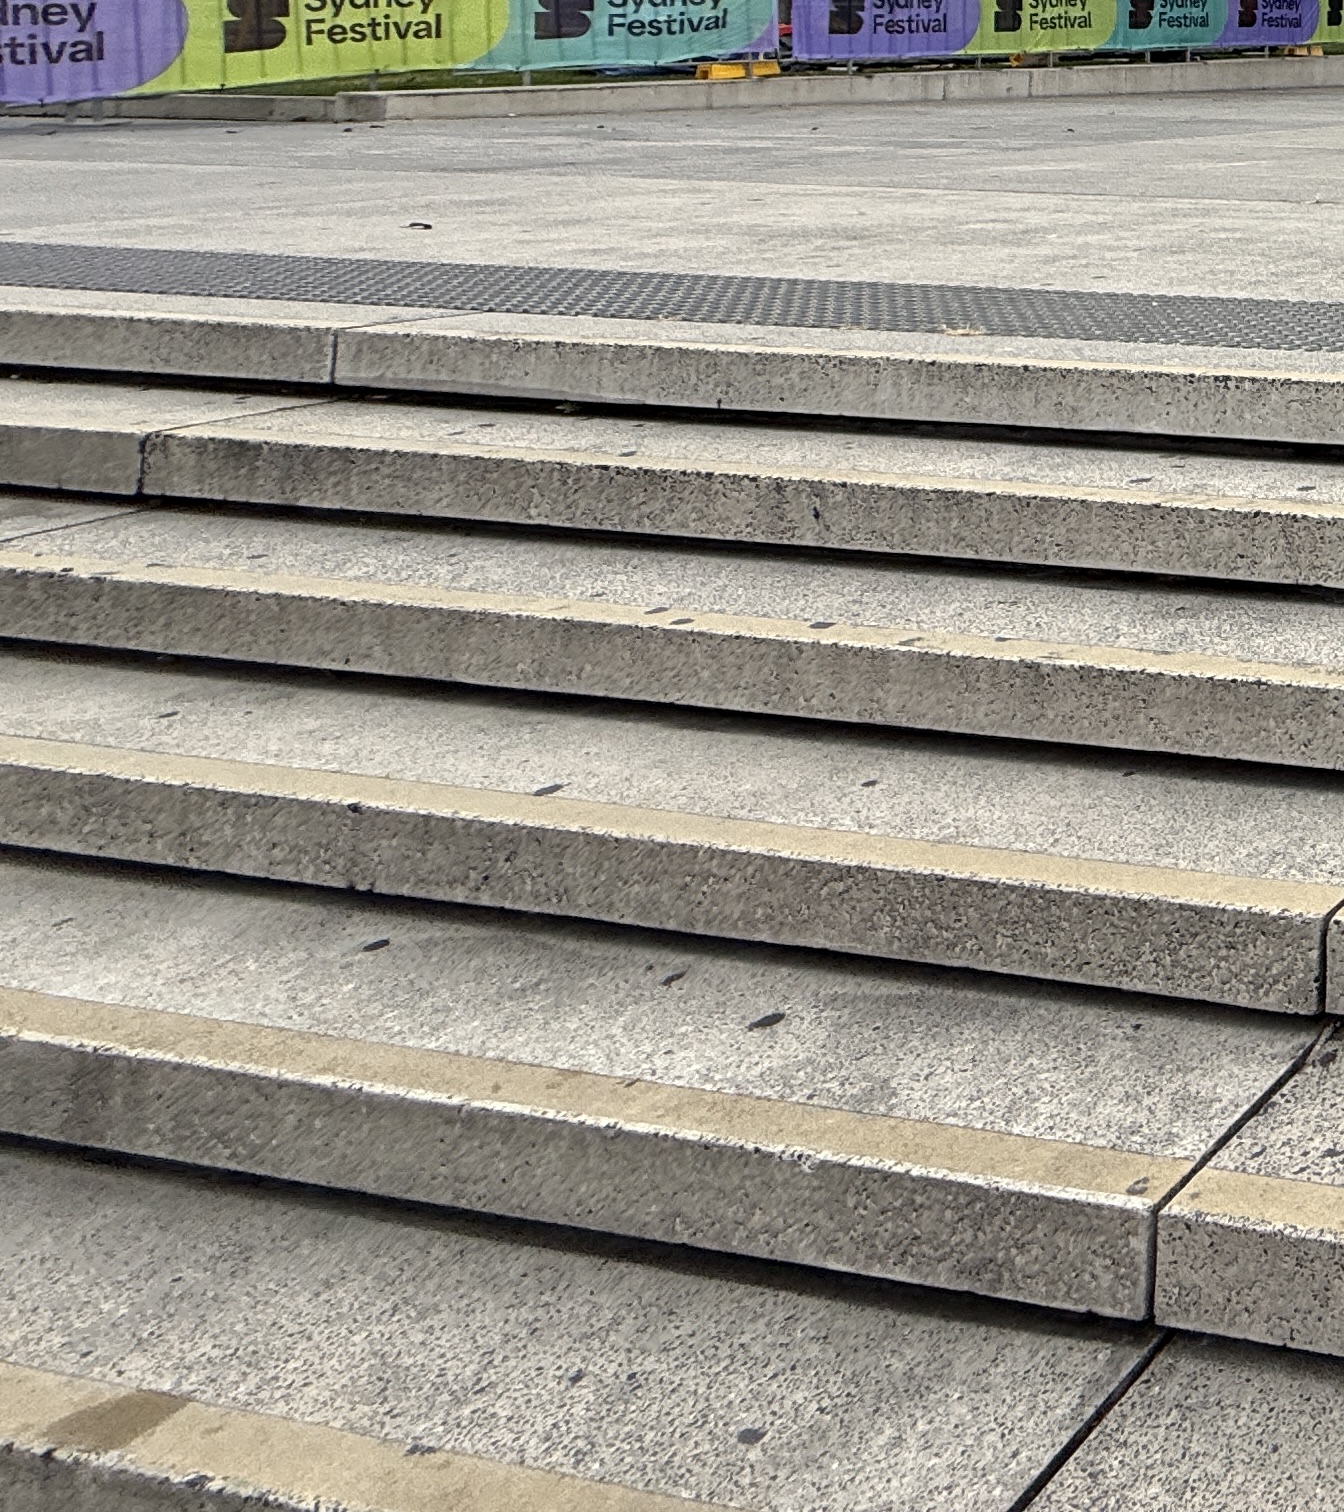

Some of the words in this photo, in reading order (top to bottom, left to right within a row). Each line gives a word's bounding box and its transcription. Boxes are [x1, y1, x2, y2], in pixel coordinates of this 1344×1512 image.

[305, 13, 442, 46] Festival
[607, 8, 728, 37] Festival
[873, 12, 947, 35] Festival
[1029, 10, 1092, 31] Festival
[1159, 11, 1209, 29] Festival
[1261, 12, 1302, 29] Festival
[0, 30, 104, 66] tival
